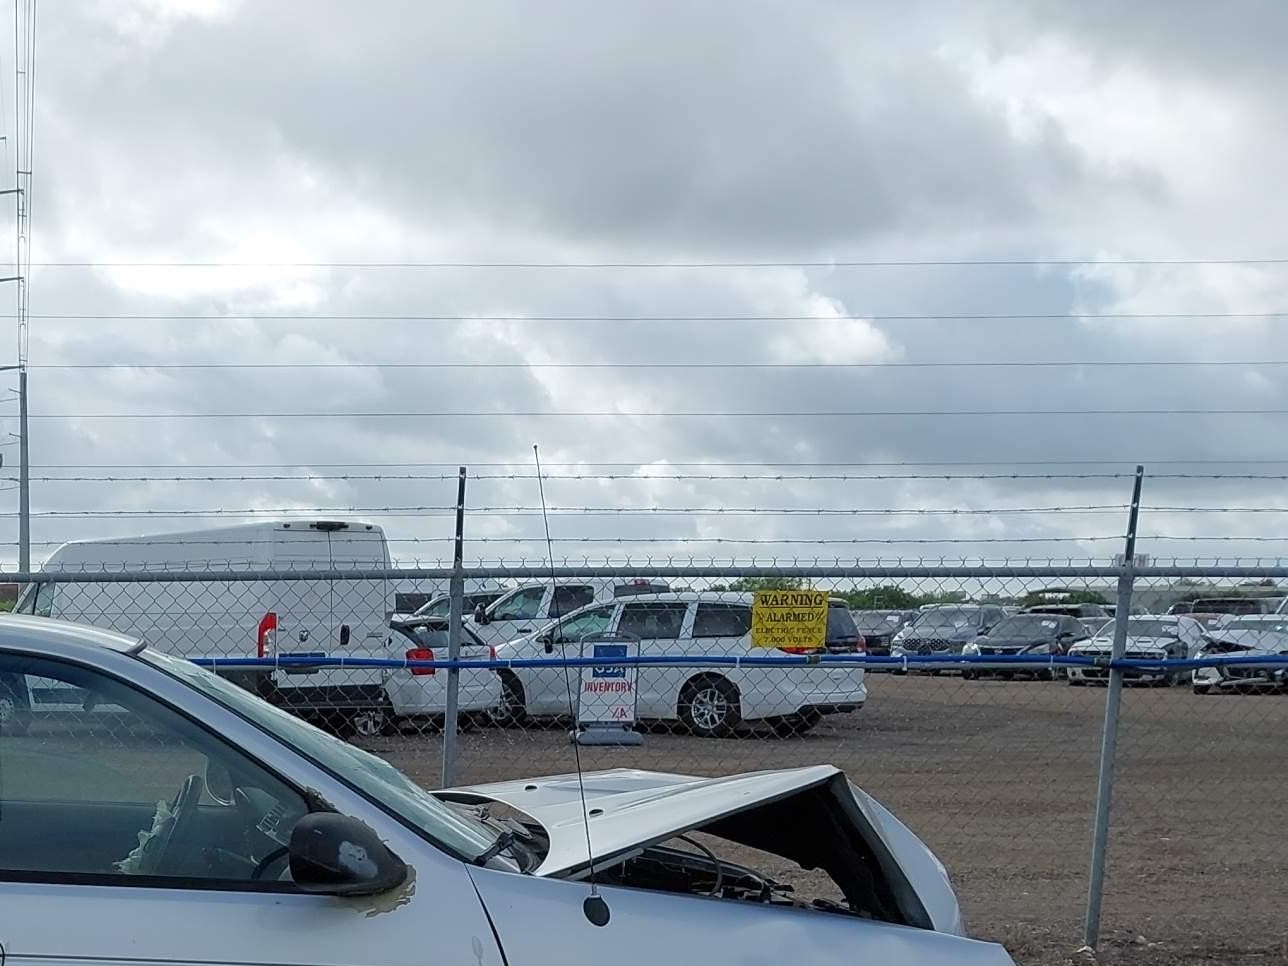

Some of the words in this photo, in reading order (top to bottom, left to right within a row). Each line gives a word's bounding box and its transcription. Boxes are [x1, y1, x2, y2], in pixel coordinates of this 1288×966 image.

[760, 593, 824, 606] WARNING
[765, 612, 814, 622] ALARMED
[584, 681, 632, 692] INVENTORY
